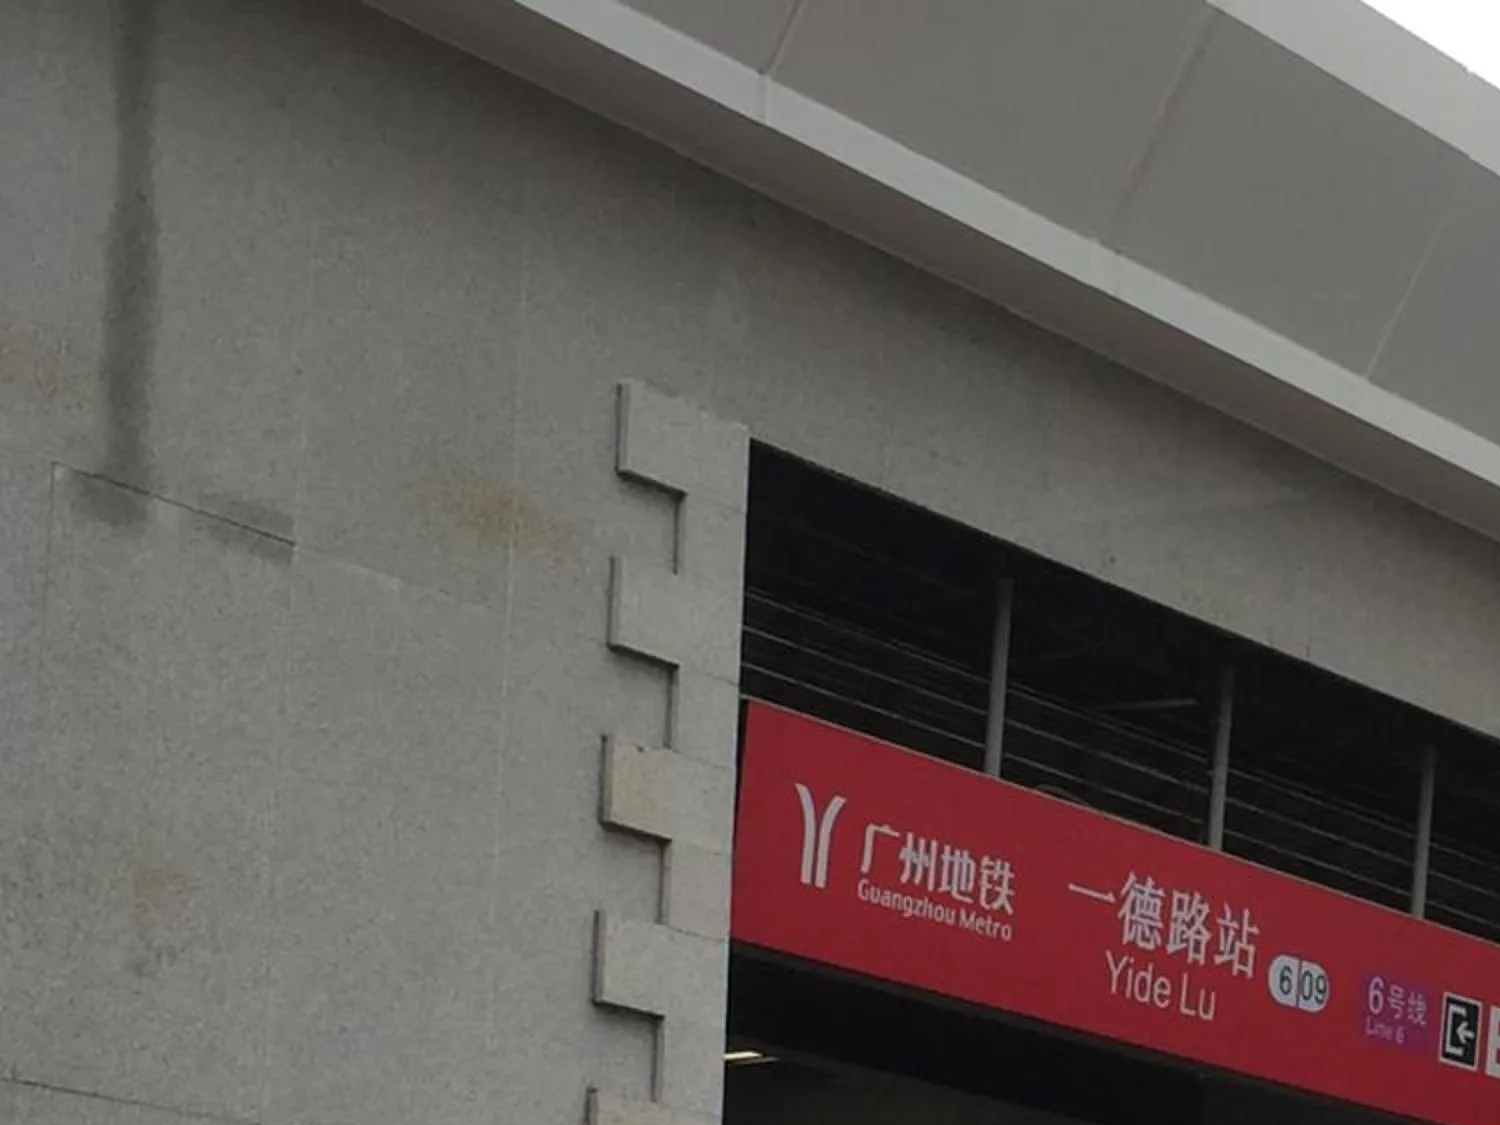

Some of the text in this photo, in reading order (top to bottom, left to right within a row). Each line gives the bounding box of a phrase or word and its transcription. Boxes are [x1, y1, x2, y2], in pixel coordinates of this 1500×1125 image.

[857, 878, 1013, 942] Guangzhou Metro
[860, 823, 1015, 915] 广州地铁
[1067, 871, 1259, 979] 一德路站
[1105, 949, 1216, 1021] Yide Lu
